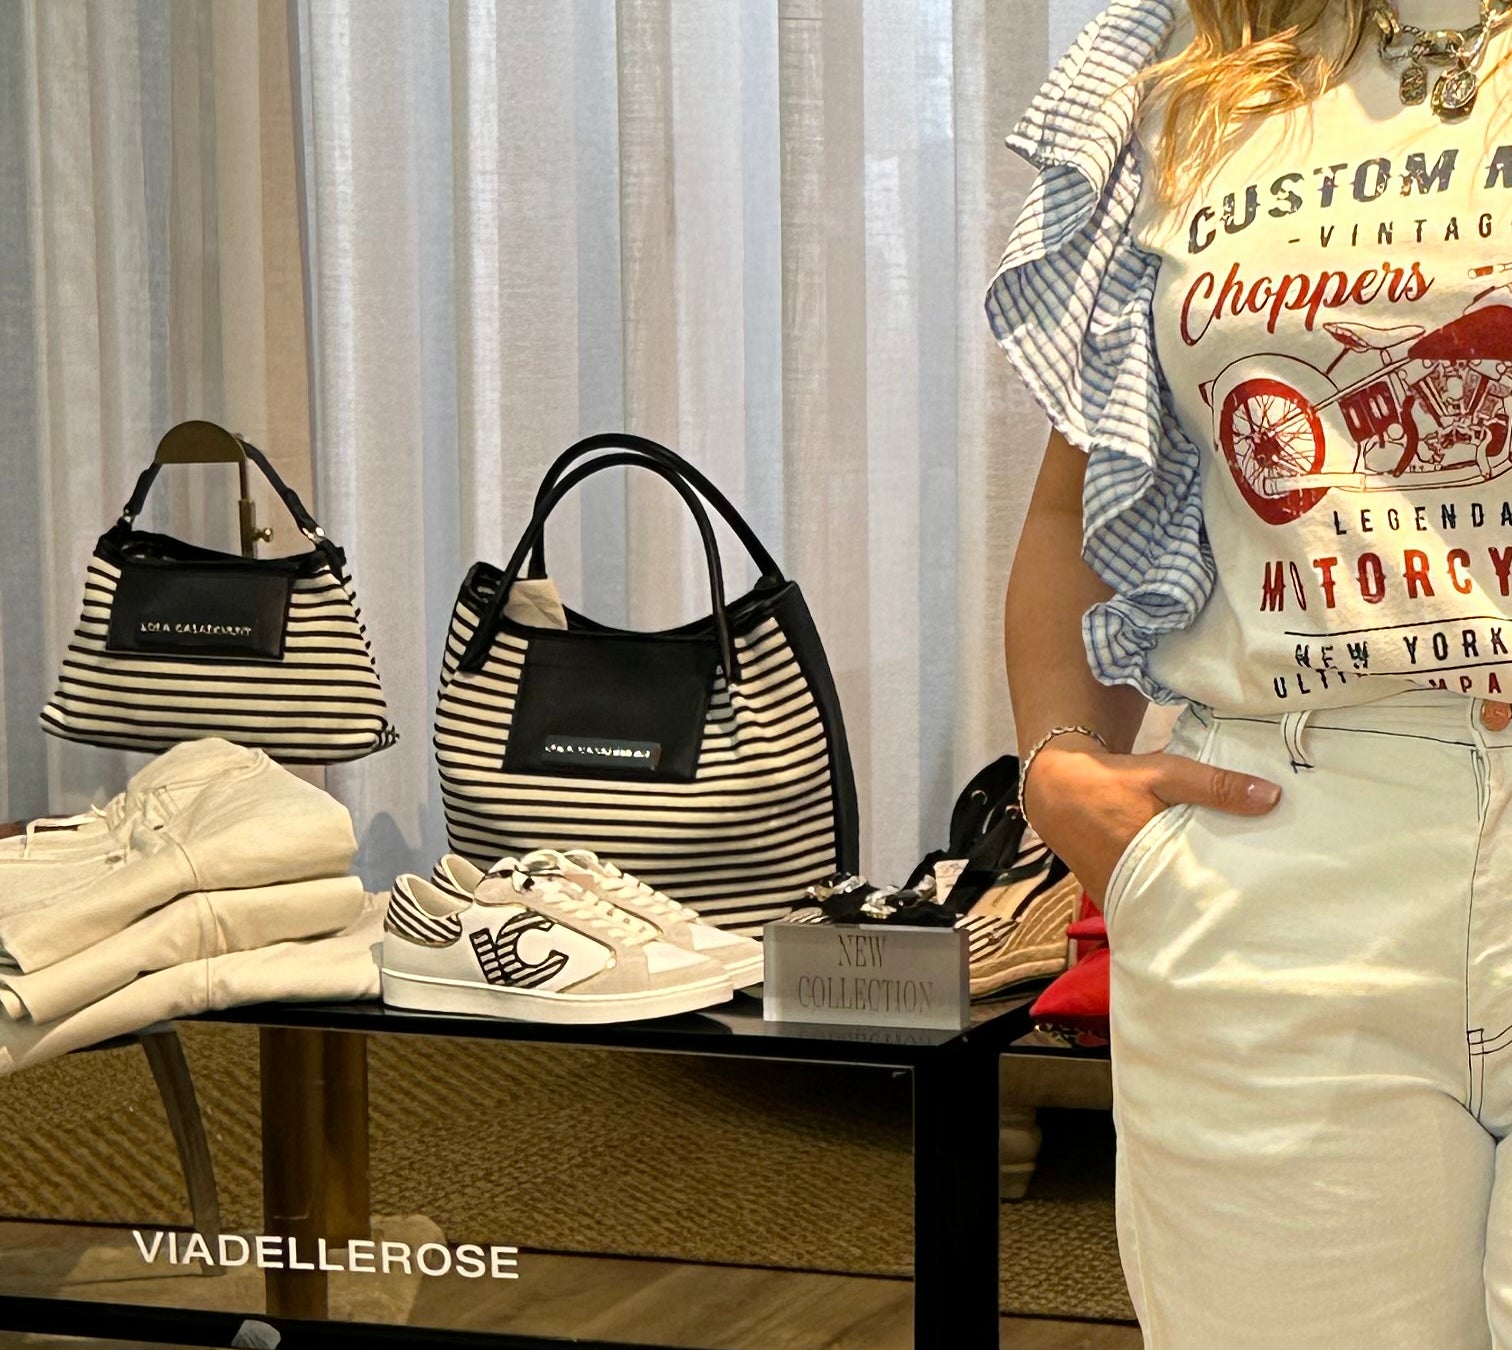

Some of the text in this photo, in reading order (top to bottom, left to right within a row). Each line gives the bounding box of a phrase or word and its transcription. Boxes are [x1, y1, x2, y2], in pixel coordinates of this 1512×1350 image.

[1187, 148, 1460, 255] CUSTOM
[1179, 261, 1435, 346] Choppers
[1402, 626, 1509, 665] YORK
[837, 933, 887, 969] NEW
[798, 974, 934, 1015] COLLECTION
[131, 1229, 520, 1280] VIADELLEROSE
